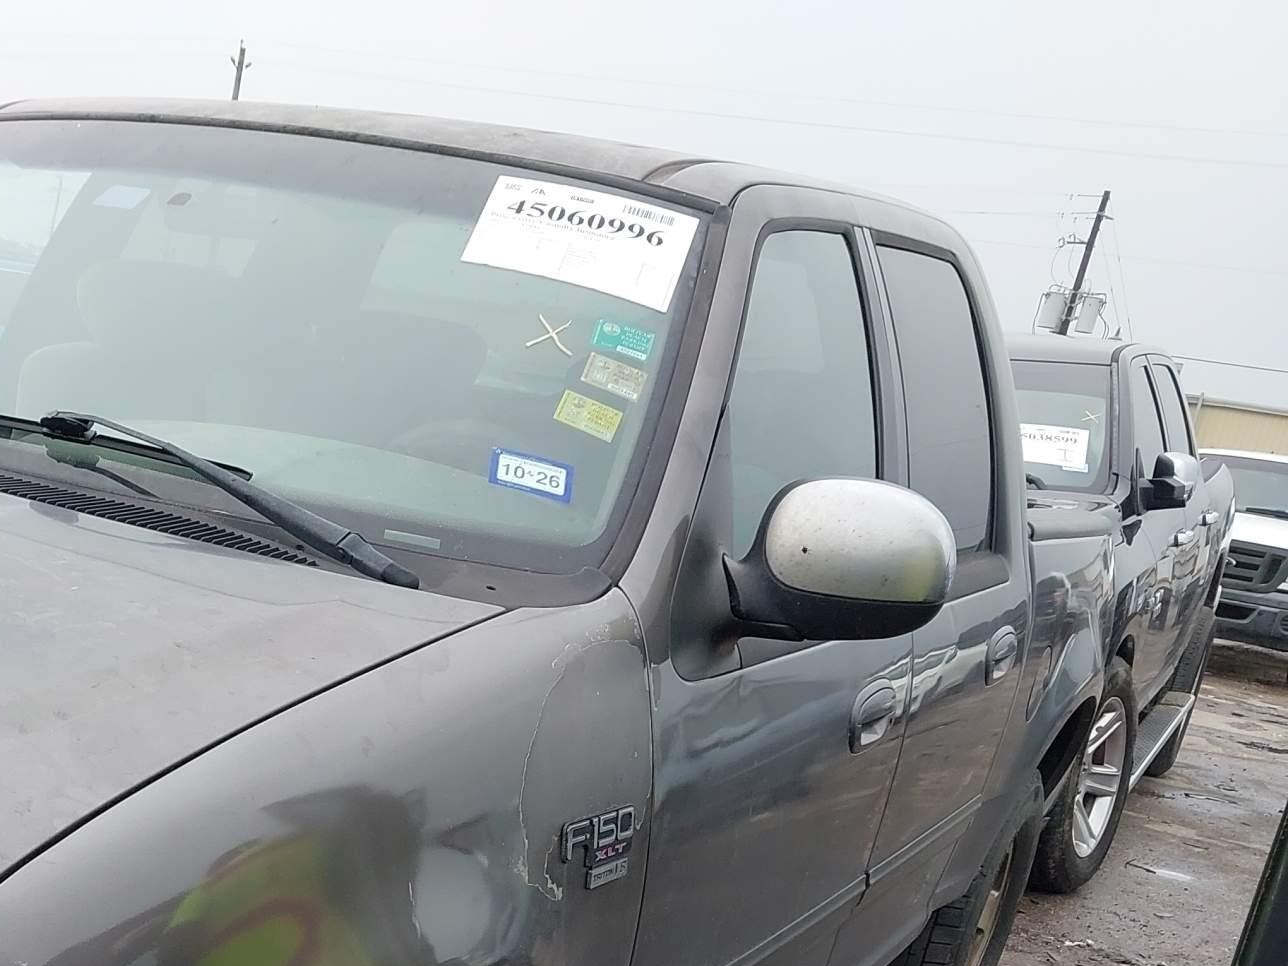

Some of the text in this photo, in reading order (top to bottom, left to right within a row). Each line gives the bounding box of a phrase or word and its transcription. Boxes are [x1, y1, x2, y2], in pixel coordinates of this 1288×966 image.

[507, 199, 665, 247] 45060996
[502, 463, 526, 480] 10
[535, 471, 561, 489] 26
[595, 841, 627, 863] XLT
